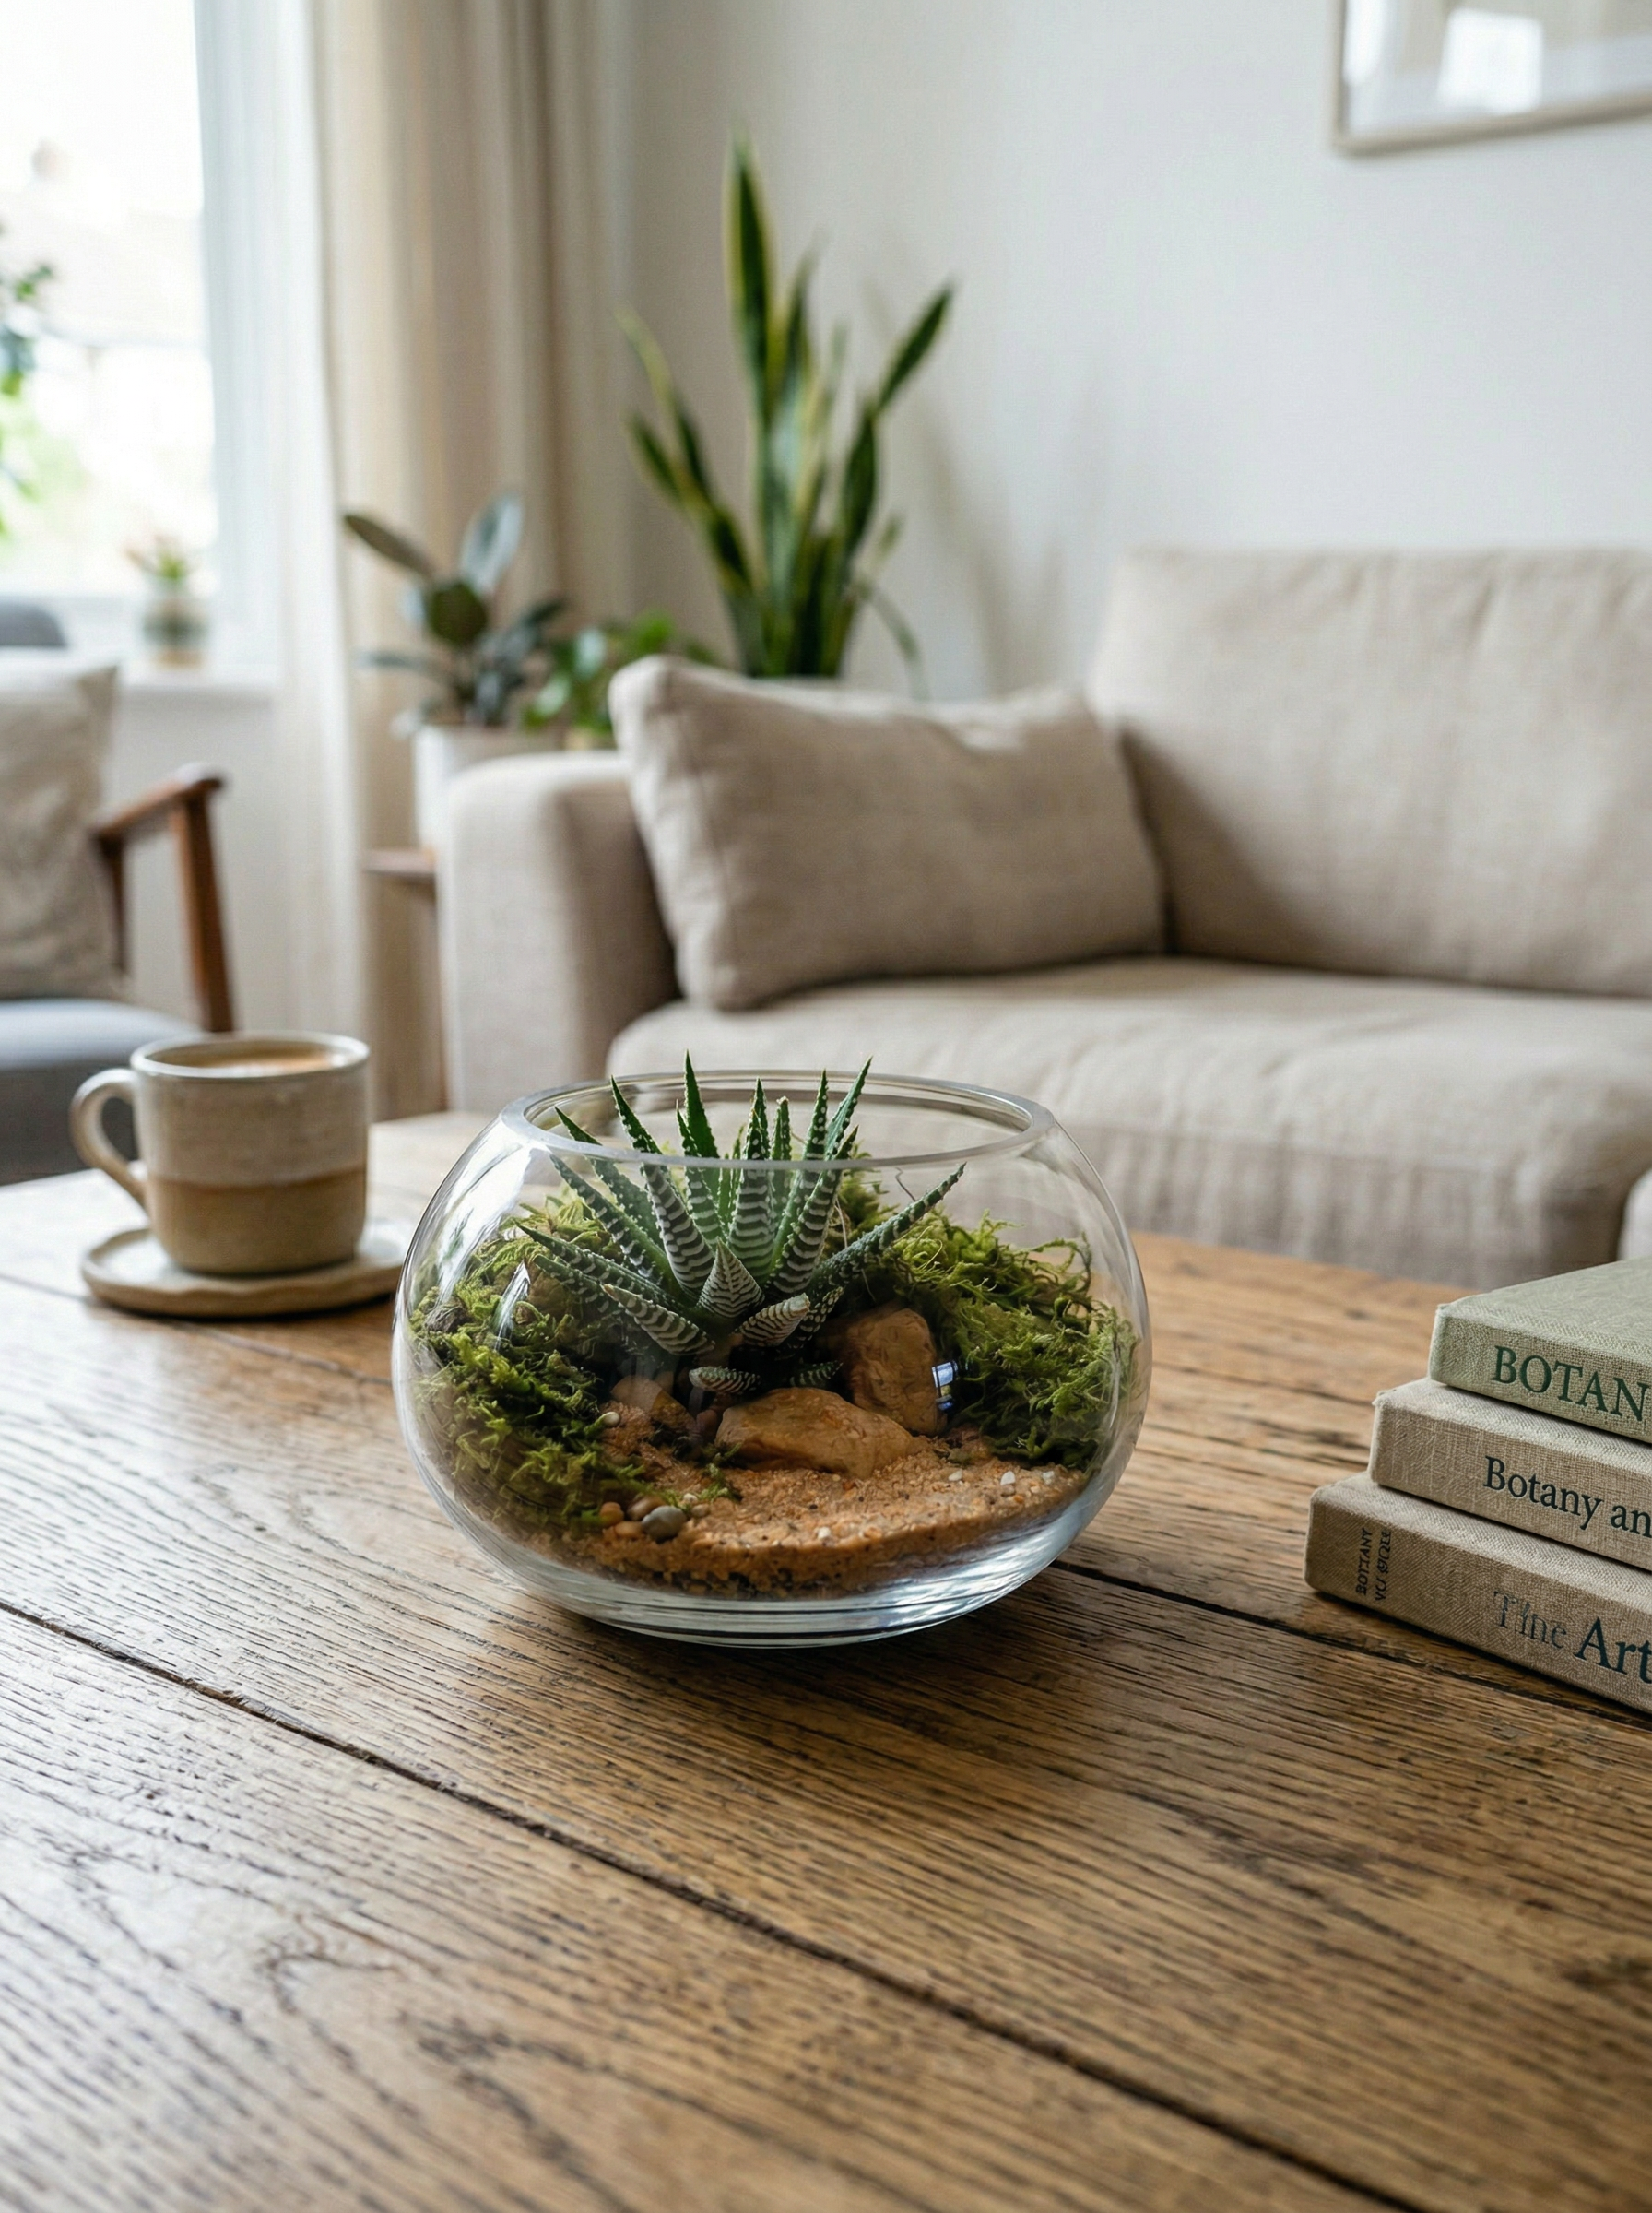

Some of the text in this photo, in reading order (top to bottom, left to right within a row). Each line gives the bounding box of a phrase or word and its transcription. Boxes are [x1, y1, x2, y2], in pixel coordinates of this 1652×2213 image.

[1490, 1345, 1650, 1422] BOTAN
[1482, 1455, 1652, 1539] Botany an
